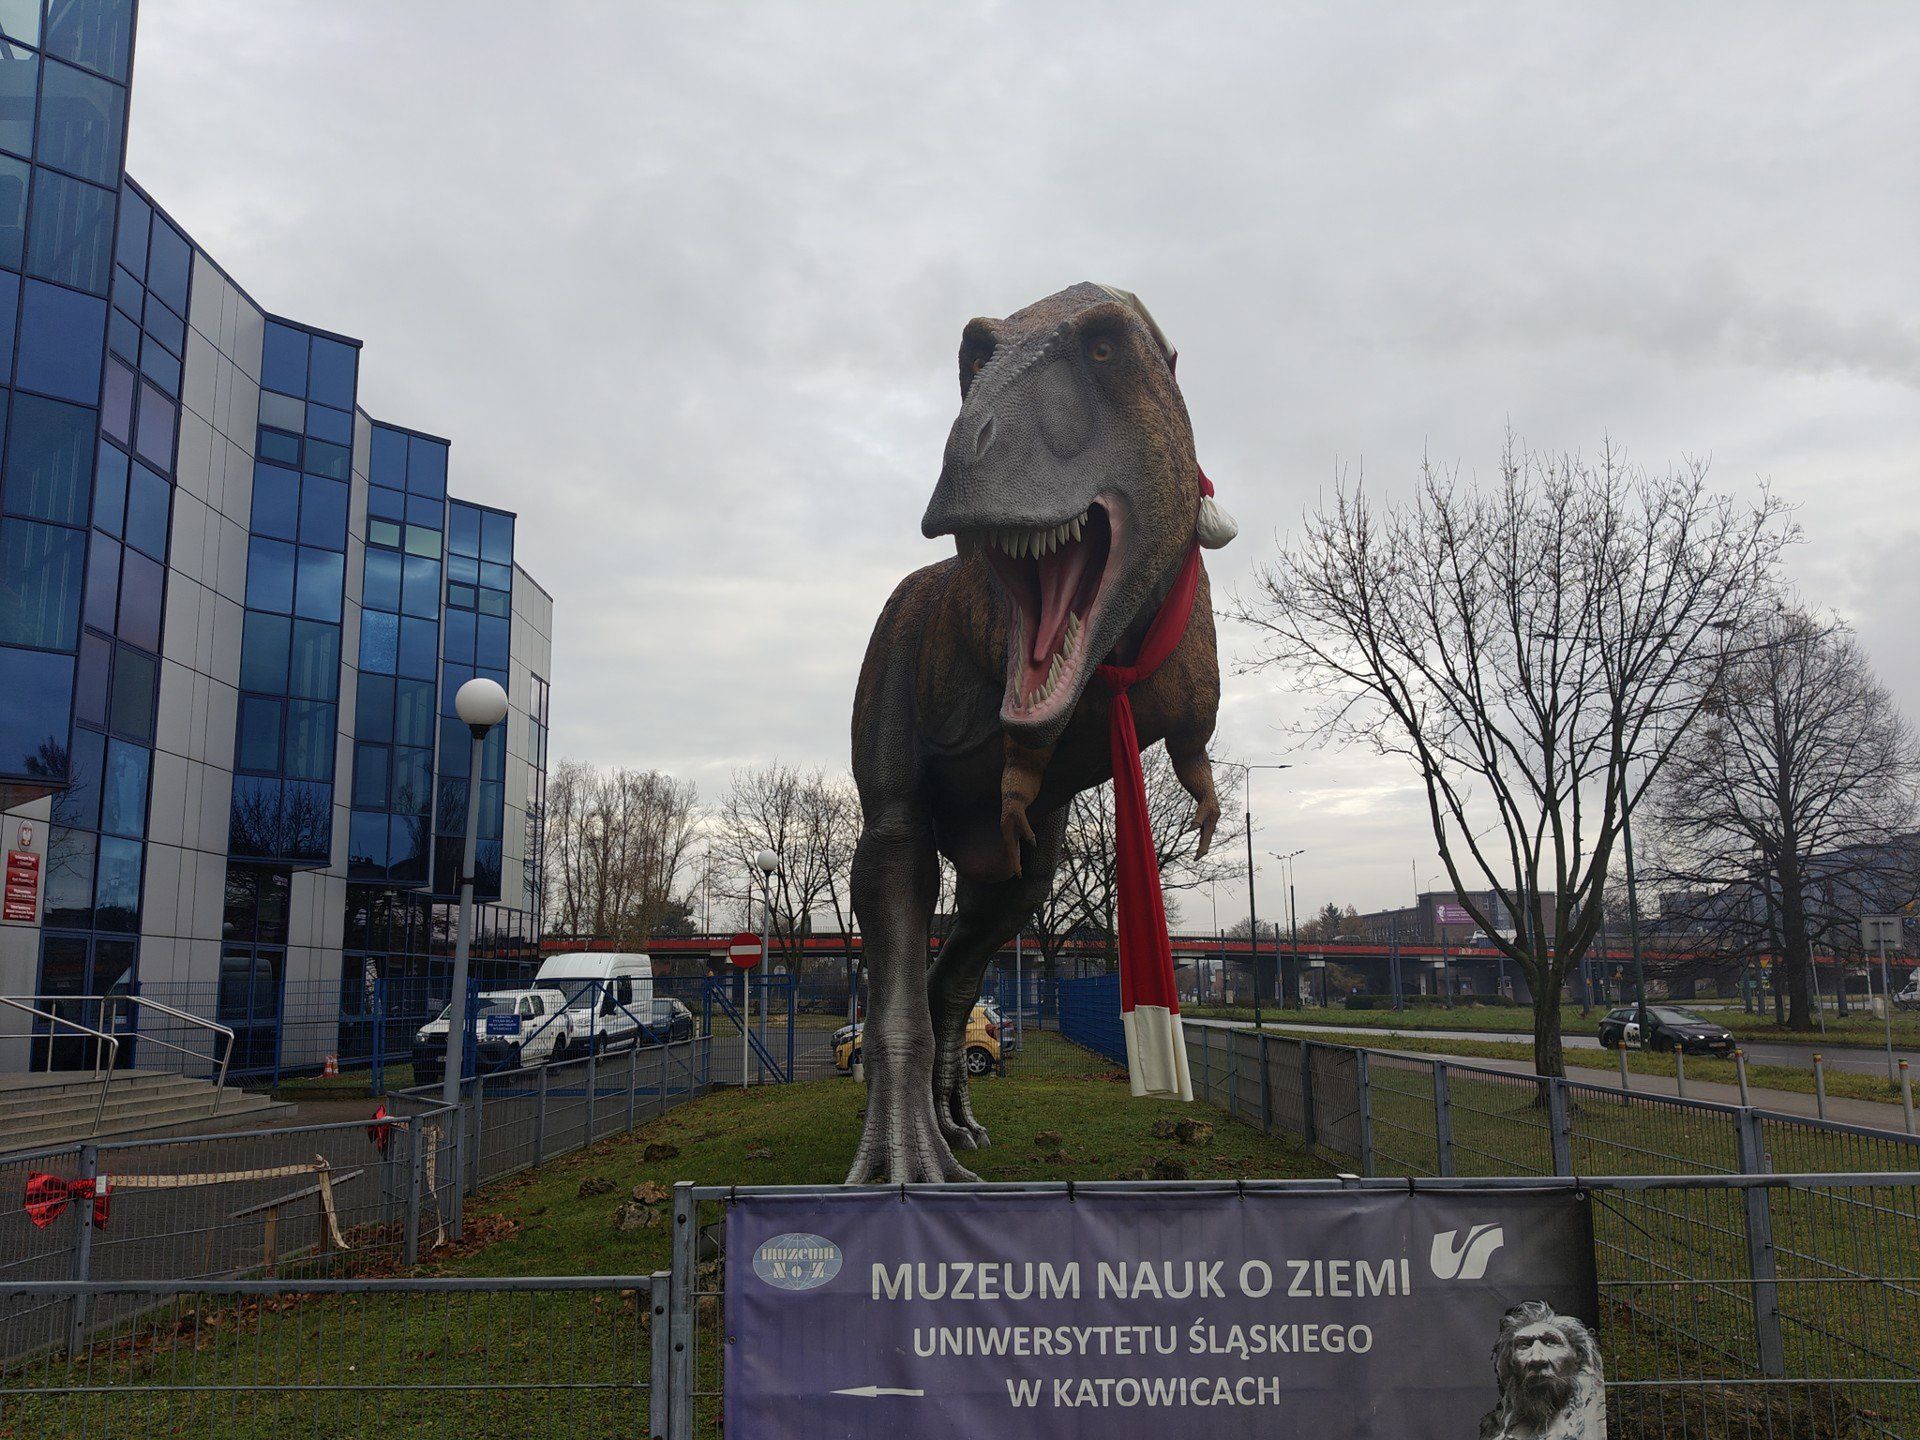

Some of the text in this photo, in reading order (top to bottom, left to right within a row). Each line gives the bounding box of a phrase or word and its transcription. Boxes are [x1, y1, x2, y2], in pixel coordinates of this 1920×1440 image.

[872, 1258, 1411, 1300] MUZEUM NAUK O ZIEMI
[913, 1317, 1373, 1361] UNIWERSYTETU ŚLĄSKIEGO
[1006, 1376, 1280, 1408] W KATOWICACH
